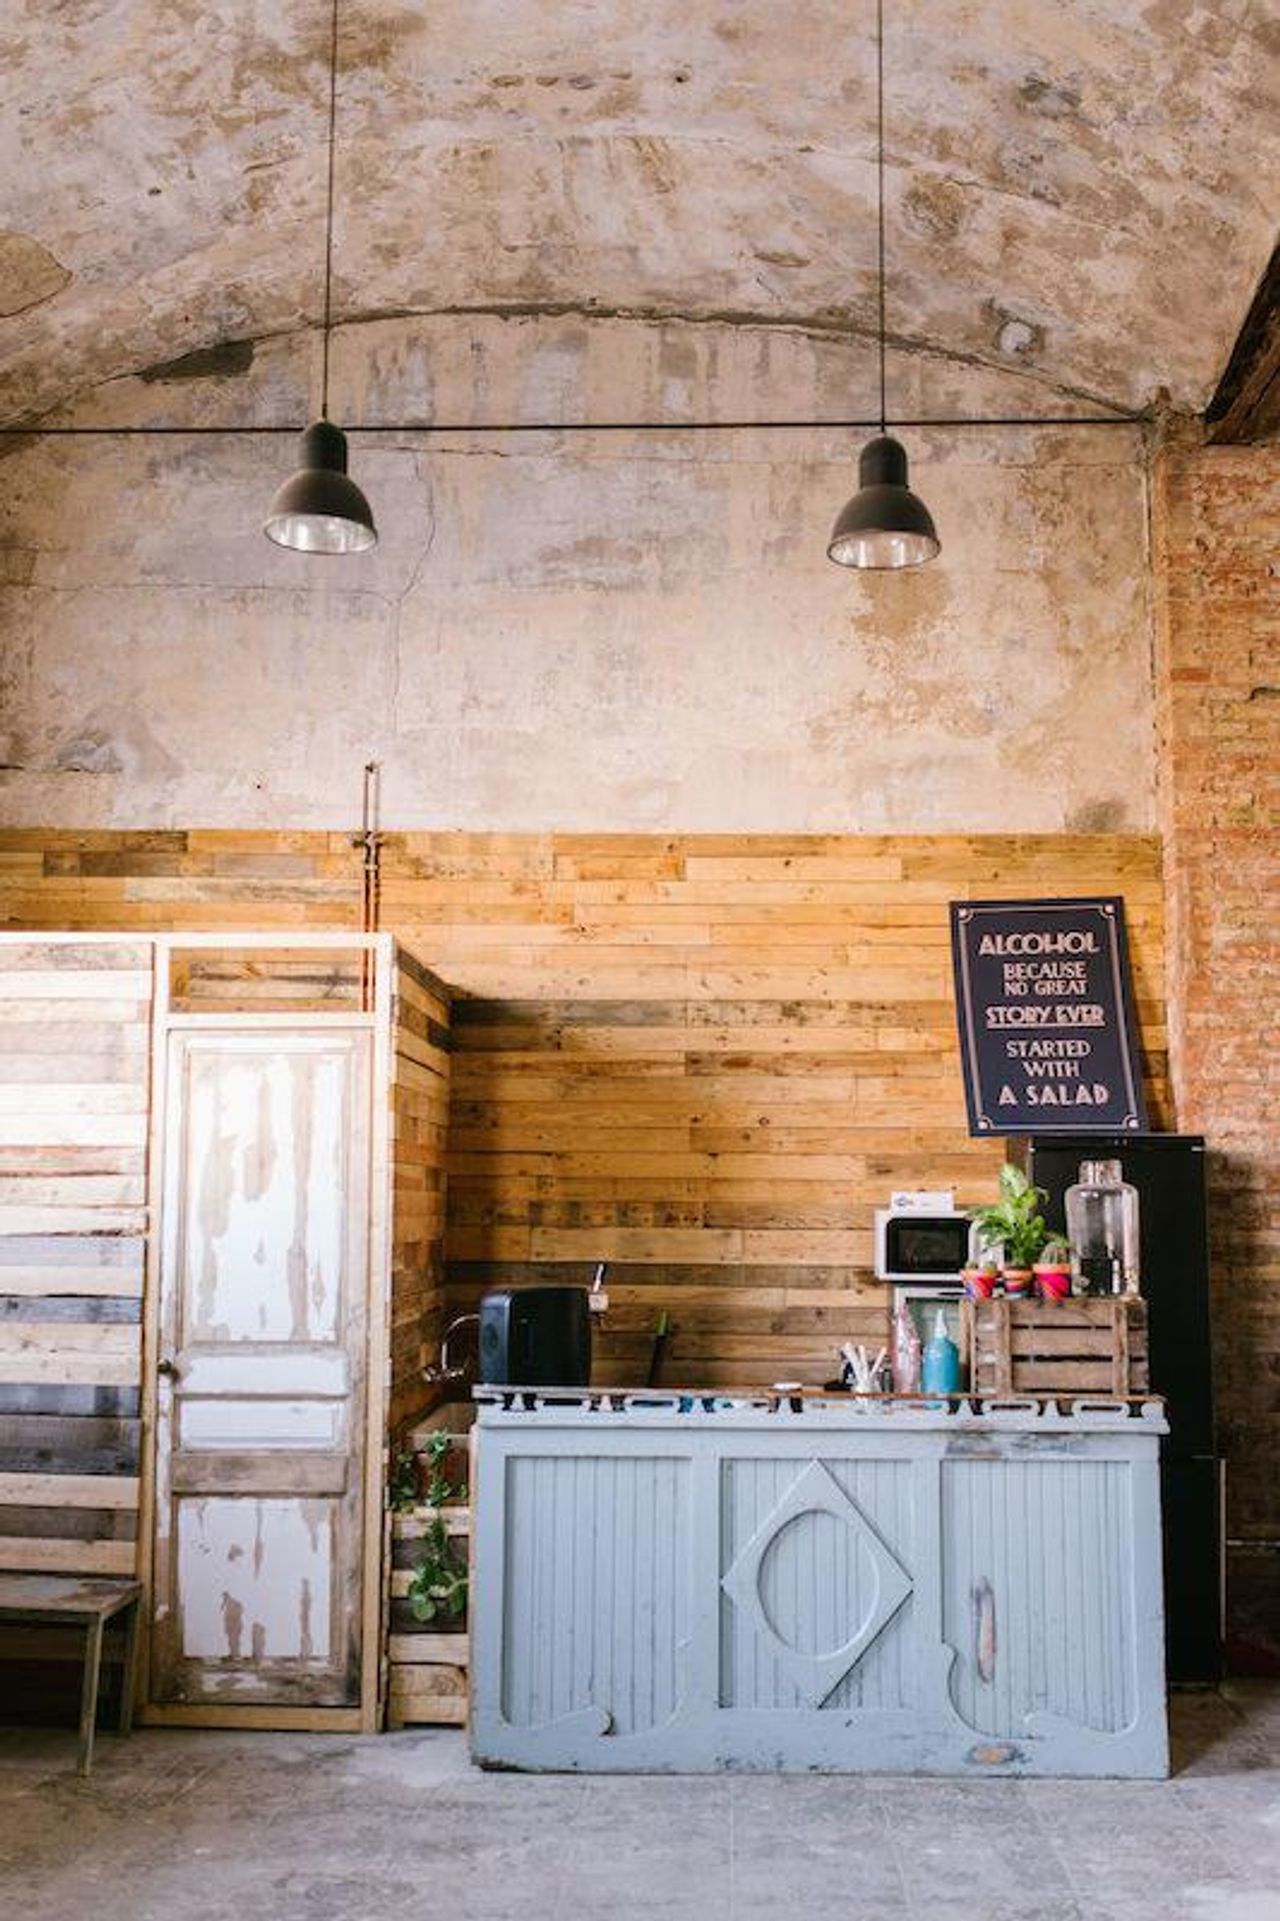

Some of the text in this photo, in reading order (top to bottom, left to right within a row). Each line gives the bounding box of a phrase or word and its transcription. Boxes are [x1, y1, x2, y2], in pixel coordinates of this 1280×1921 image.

[978, 931, 1100, 955] ALCOHOL
[1003, 961, 1087, 979] BECAUSE
[1004, 980, 1088, 996] NO GREAT
[986, 1004, 1105, 1024] STORY EVER
[1006, 1040, 1091, 1058] STARTED
[1023, 1061, 1080, 1077] WITH
[998, 1083, 1109, 1106] A SALAD
